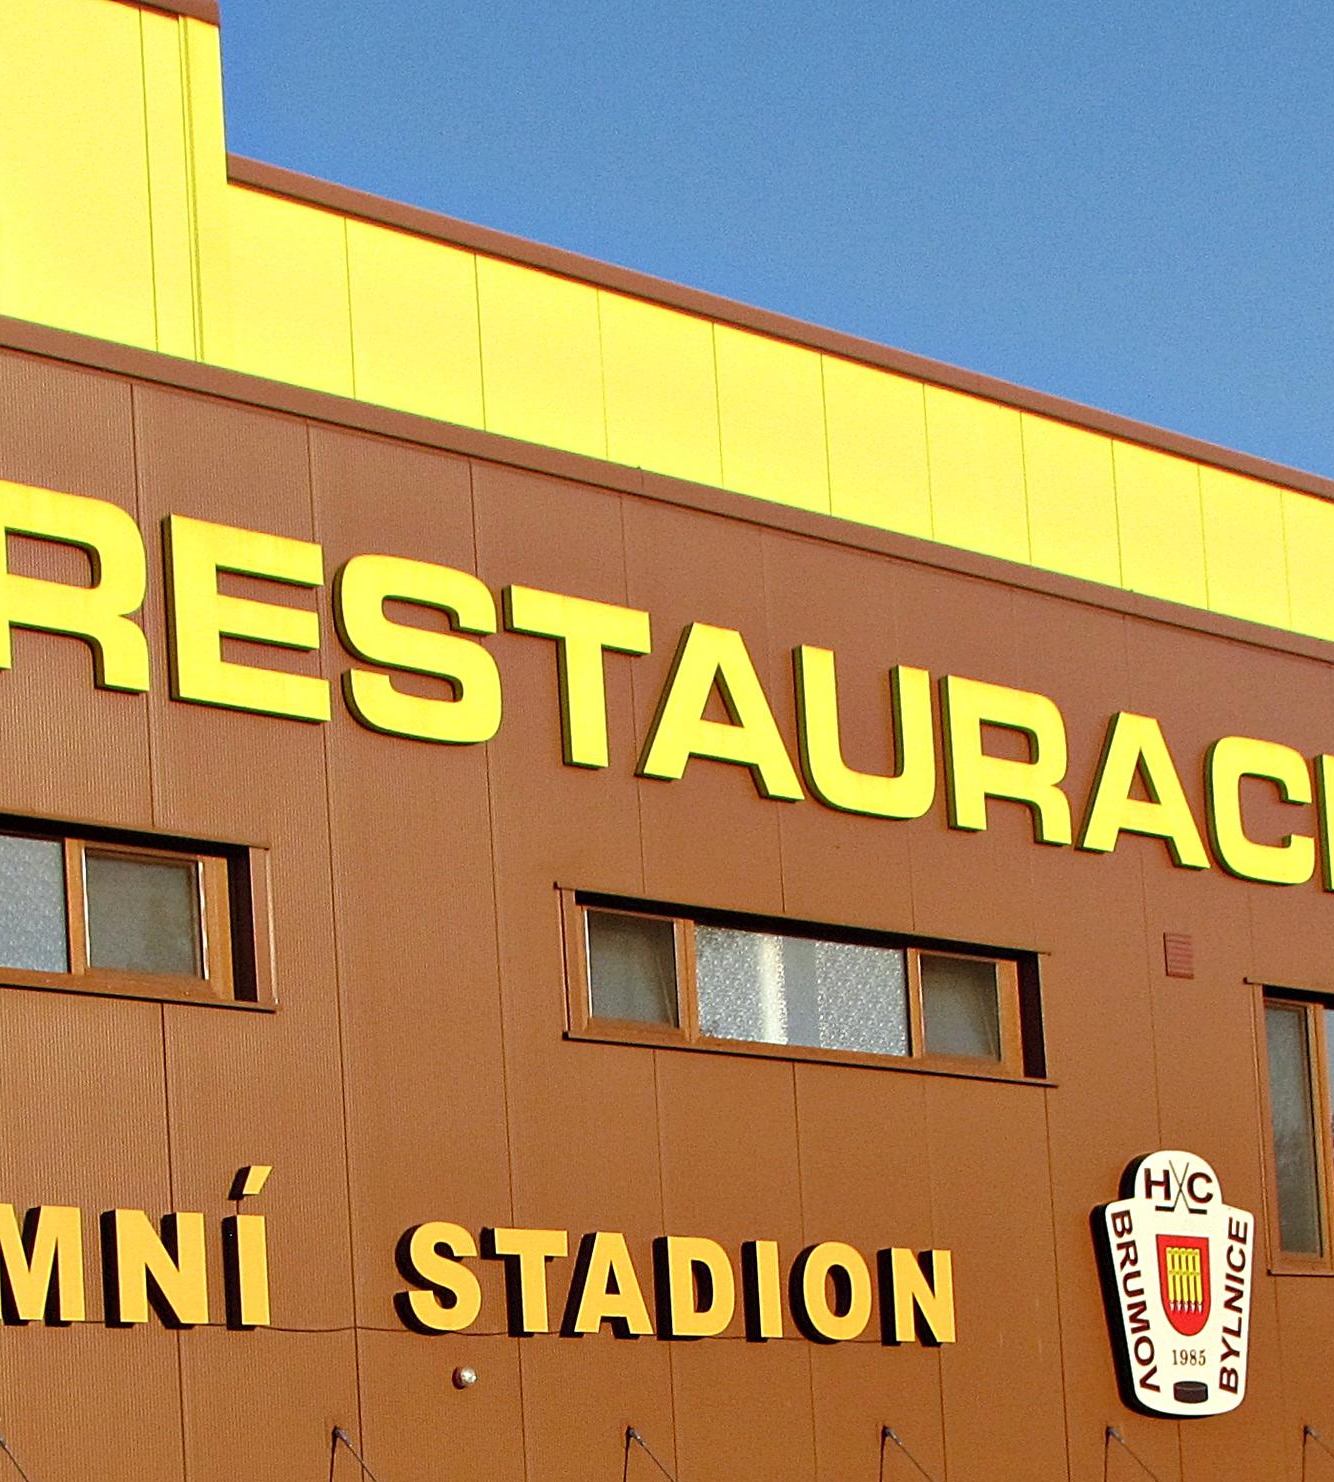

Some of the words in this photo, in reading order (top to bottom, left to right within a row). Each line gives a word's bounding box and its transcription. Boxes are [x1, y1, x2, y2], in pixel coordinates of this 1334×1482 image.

[394, 1221, 956, 1346] STADION
[1111, 1208, 1161, 1393] BRUMOV
[1172, 1348, 1207, 1366] 1985
[1218, 1216, 1248, 1394] BYLNICE
